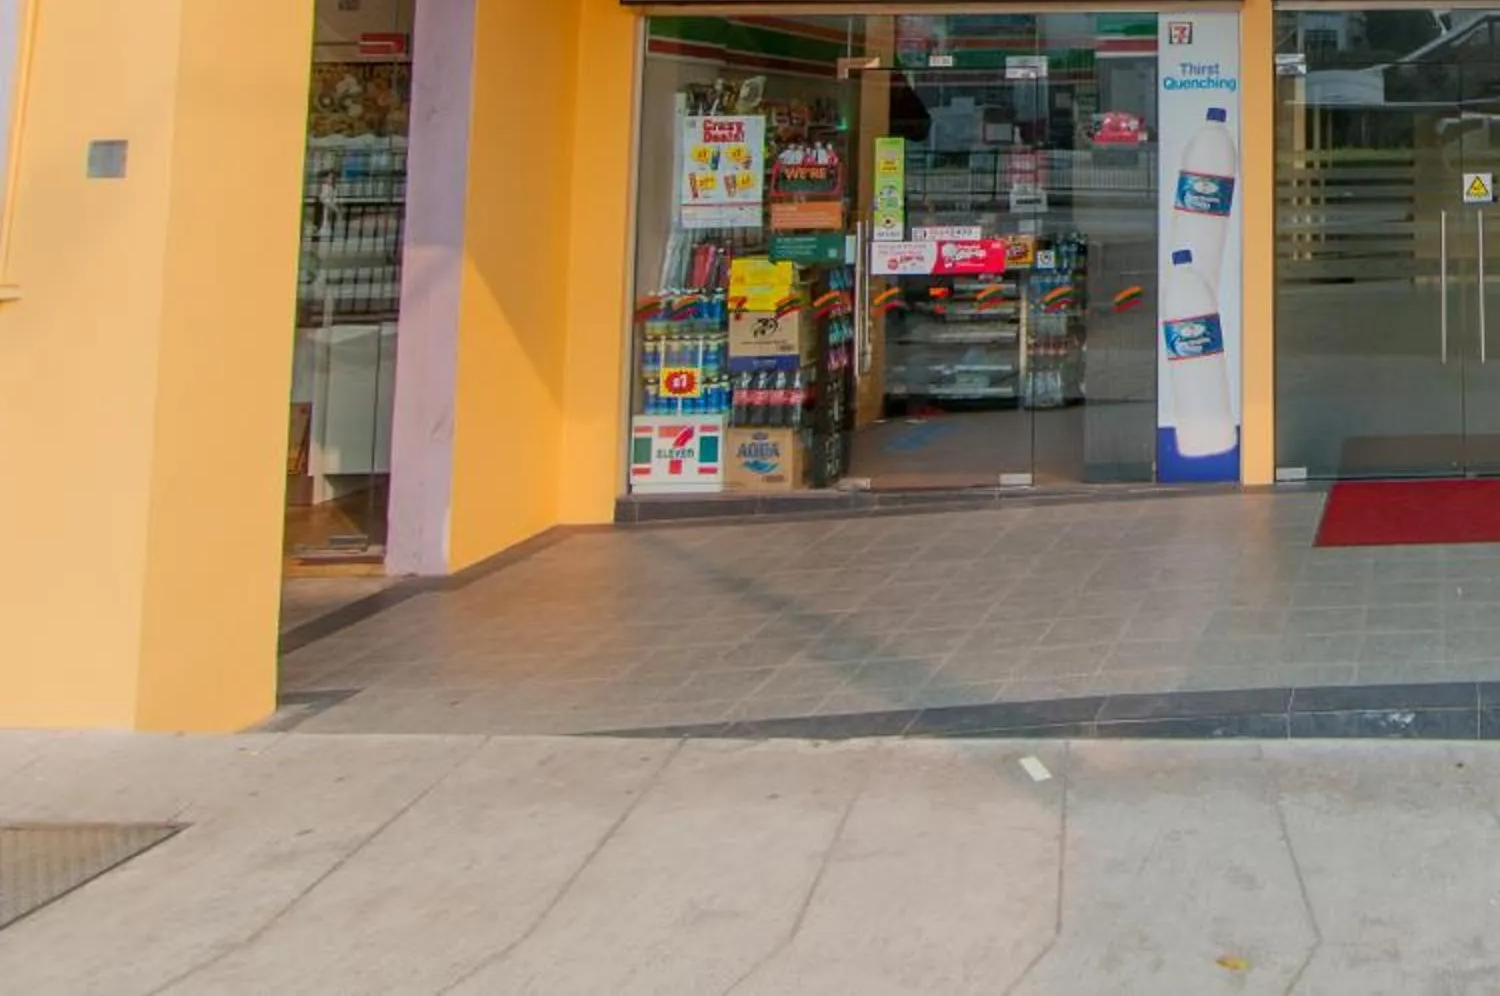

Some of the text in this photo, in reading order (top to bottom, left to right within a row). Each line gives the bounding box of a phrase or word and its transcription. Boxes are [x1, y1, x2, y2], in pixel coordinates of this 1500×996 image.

[1179, 62, 1220, 77] Thirst
[1163, 76, 1237, 93] Quenching
[656, 448, 695, 459] ELEVEN
